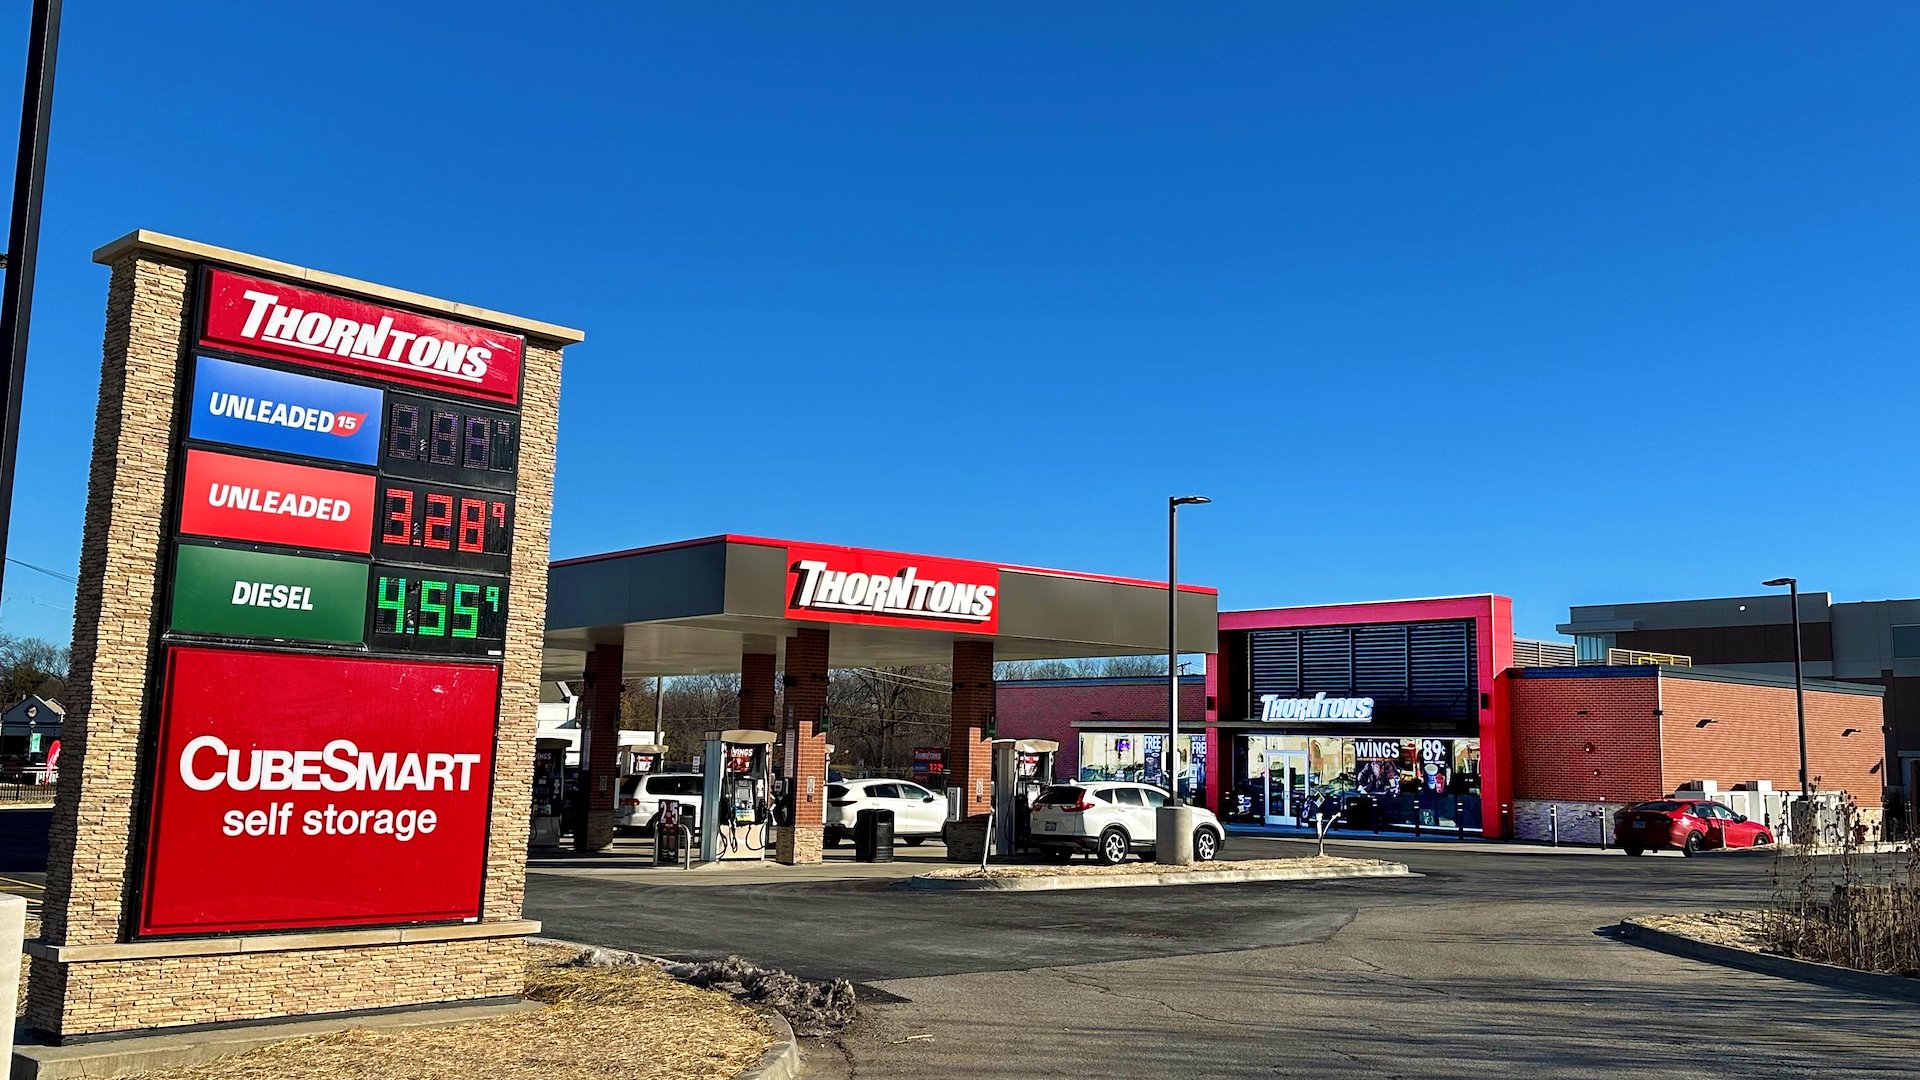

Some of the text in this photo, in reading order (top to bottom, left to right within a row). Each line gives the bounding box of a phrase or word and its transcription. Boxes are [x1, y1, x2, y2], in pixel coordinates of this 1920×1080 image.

[238, 290, 493, 382] THORNTONS
[208, 391, 357, 434] UNLEADED 15
[208, 482, 351, 522] UNLEADED
[231, 580, 314, 611] DIESEL
[797, 559, 997, 622] THORNTONS
[1260, 692, 1374, 722] THORNTONS
[1144, 735, 1161, 750] FREE
[1192, 742, 1207, 754] FRE
[1355, 741, 1399, 759] WINGS
[179, 735, 481, 792] CUBESMART
[222, 802, 438, 841] self storage
